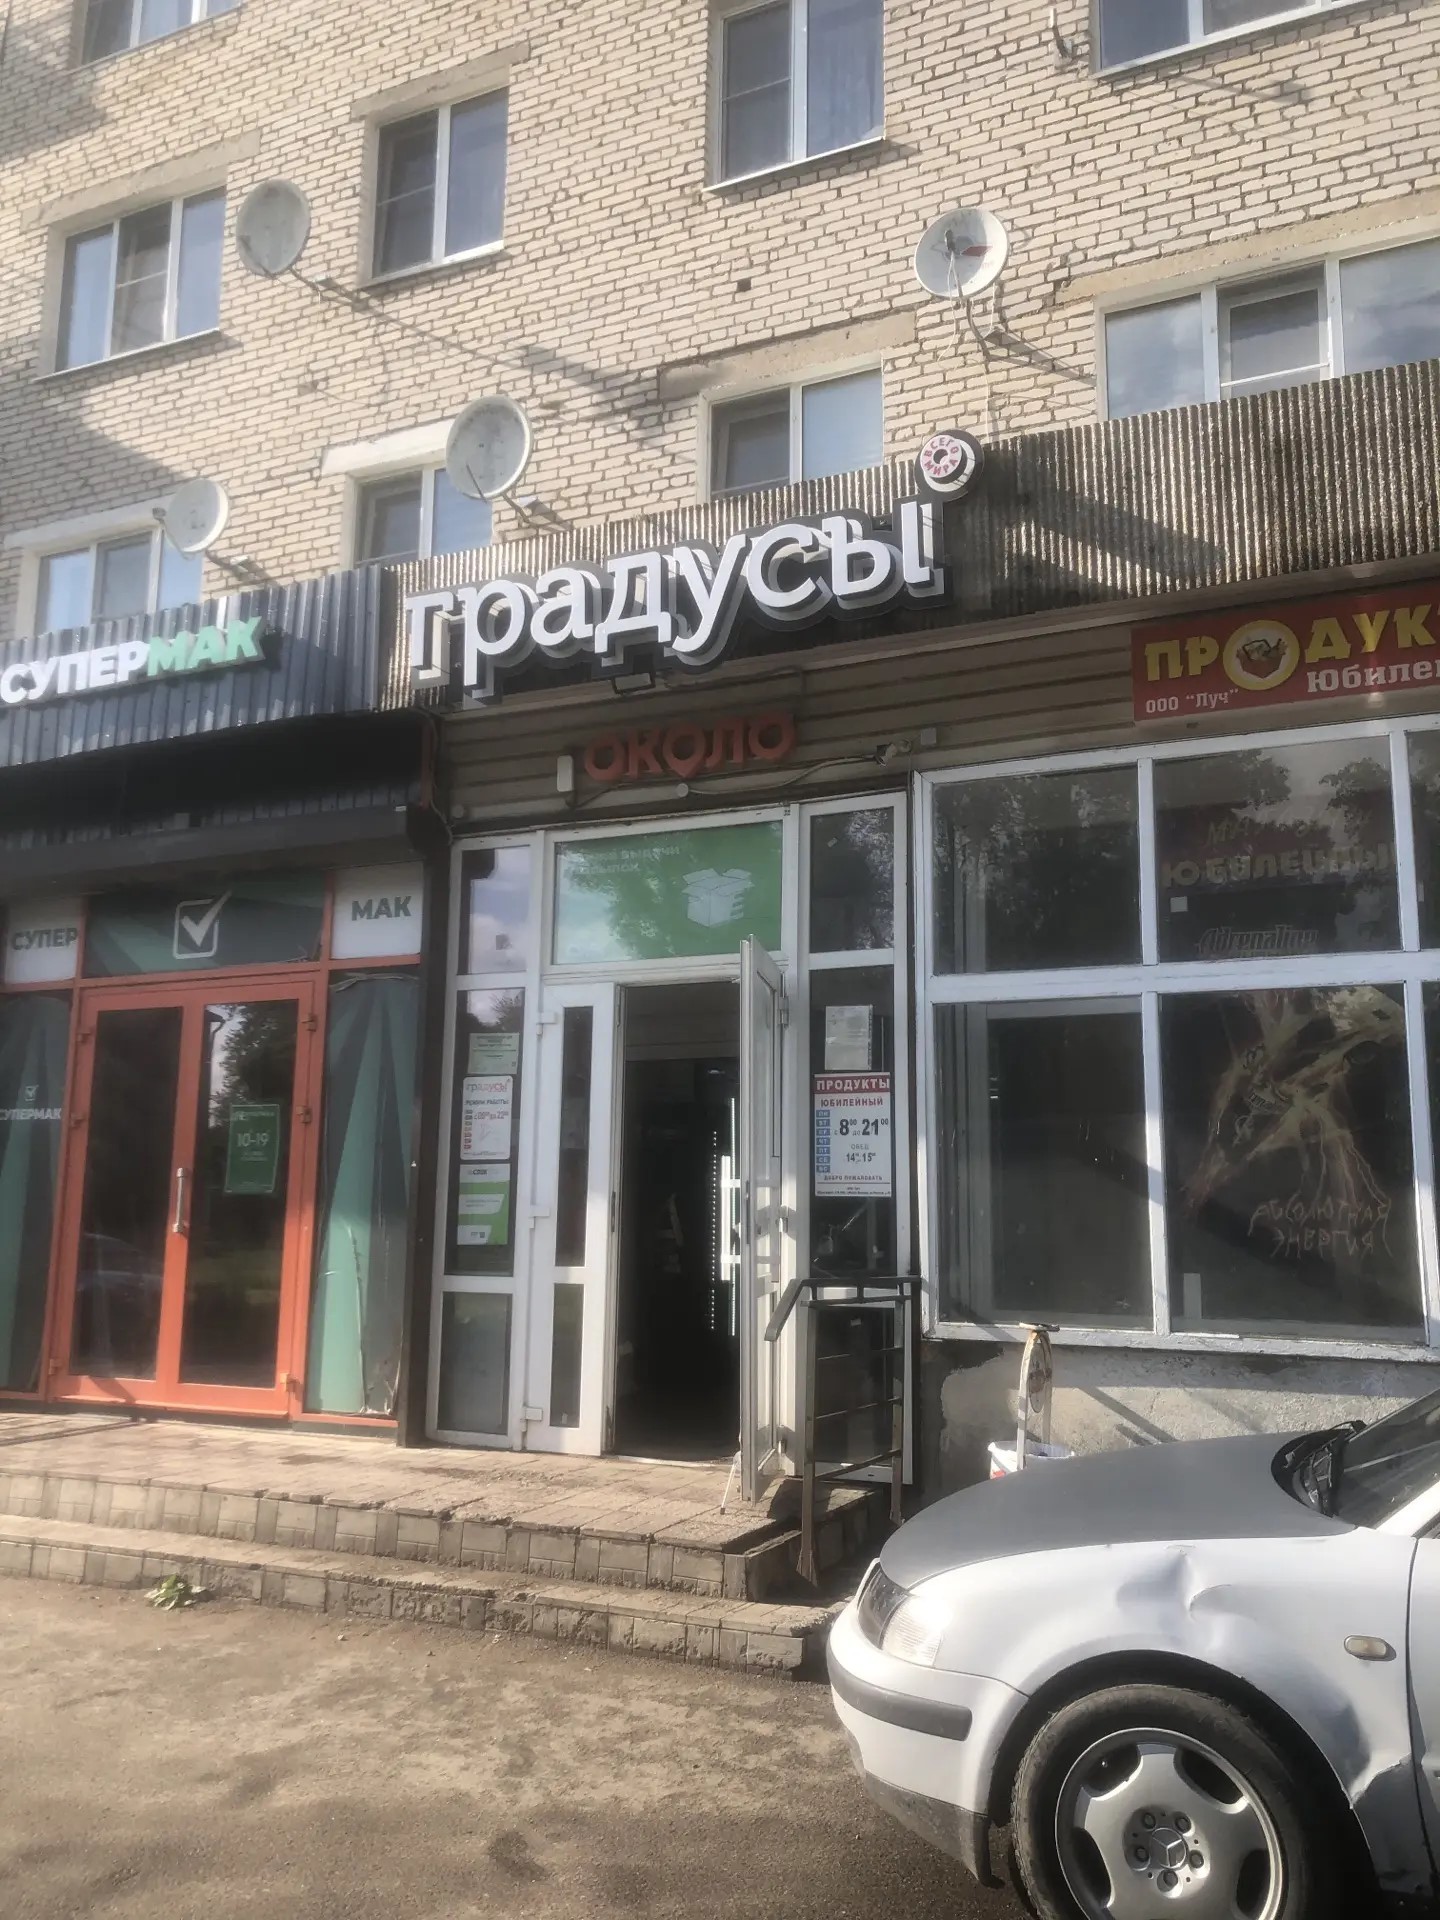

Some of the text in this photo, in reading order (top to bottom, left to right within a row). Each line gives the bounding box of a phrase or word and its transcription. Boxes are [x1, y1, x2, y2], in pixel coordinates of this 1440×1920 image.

[924, 437, 960, 457] ВСЕГО
[924, 460, 958, 476] МИРА
[405, 501, 931, 686] градусы
[0, 616, 262, 704] СУПЕРМАК
[1144, 603, 1440, 691] ПРОДУК
[1146, 696, 1179, 713] ООО
[583, 710, 796, 781] ОКОЛО
[1160, 843, 1395, 888] ЮБИЛЕЙНЫ
[351, 895, 413, 921] МАК
[11, 926, 79, 952] СУПЕР
[816, 1078, 890, 1092] ПРОДУКТЫ
[820, 1096, 883, 1107] ЮБИЛЕЙНЫЙ
